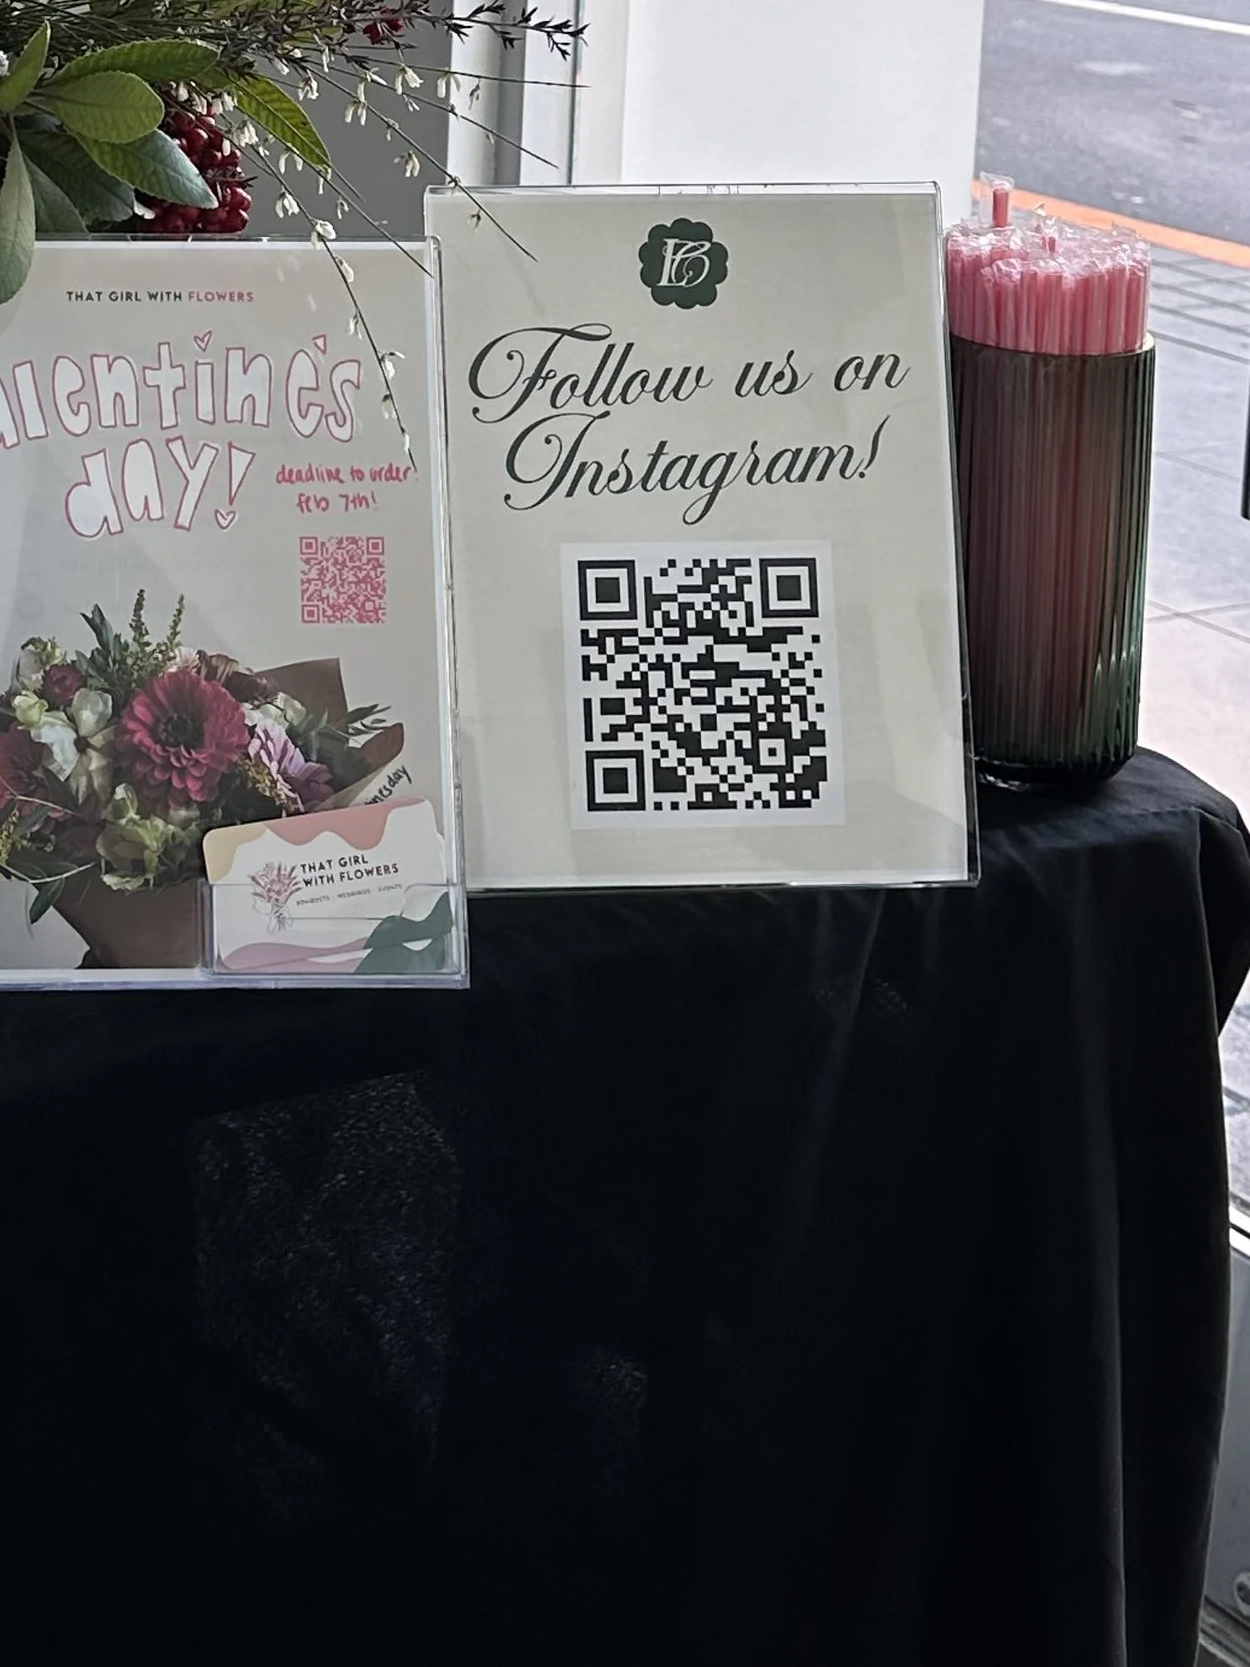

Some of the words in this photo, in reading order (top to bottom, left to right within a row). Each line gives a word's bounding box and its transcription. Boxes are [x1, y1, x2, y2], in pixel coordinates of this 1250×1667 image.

[66, 290, 103, 303] THAT
[108, 290, 142, 303] GIRL
[147, 291, 183, 303] WITH
[188, 291, 255, 303] FLOWERS
[467, 322, 714, 424] Follow
[733, 349, 813, 398] us
[833, 351, 912, 392] on
[275, 461, 346, 485] deadline
[350, 465, 365, 483] to
[503, 410, 891, 526] Instagram!
[64, 434, 256, 539] day!
[296, 492, 330, 514] feb
[338, 490, 379, 513] 7th!
[300, 859, 334, 874] THAT
[338, 854, 369, 868] GIRL
[302, 874, 335, 888] WITH
[339, 863, 399, 882] FLOWERS
